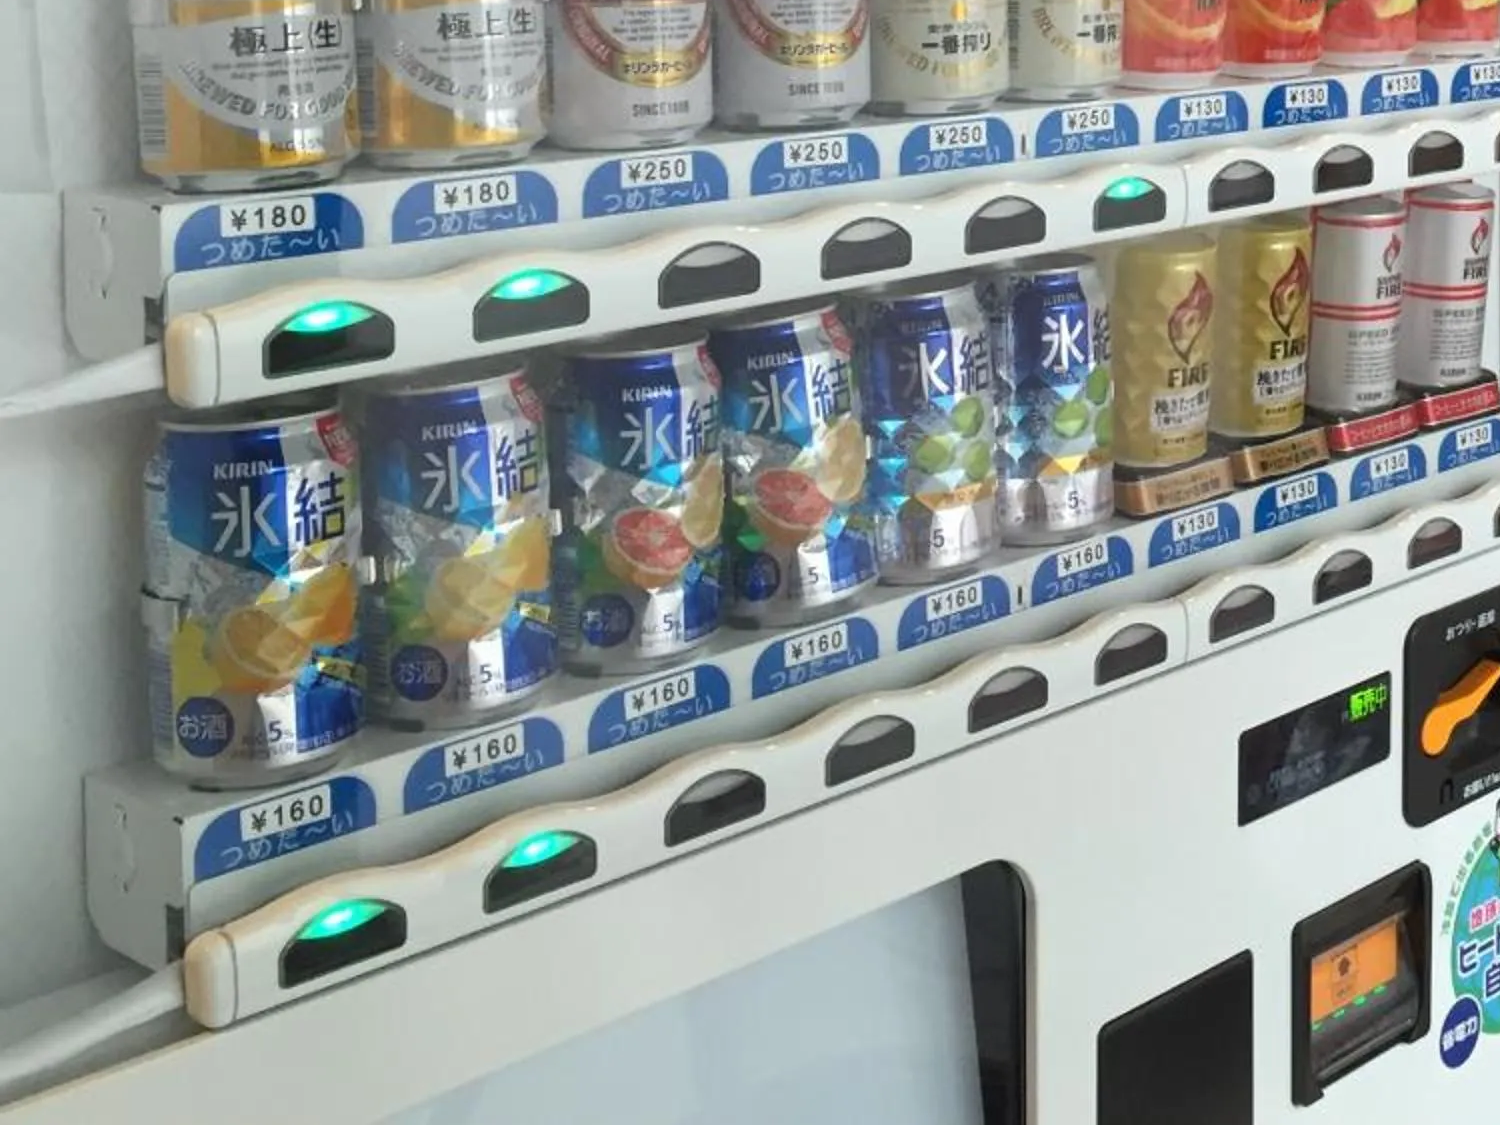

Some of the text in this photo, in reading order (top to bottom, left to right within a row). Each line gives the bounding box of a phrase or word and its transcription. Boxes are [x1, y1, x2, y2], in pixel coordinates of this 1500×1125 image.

[920, 30, 992, 56] 一番搾り
[1289, 86, 1327, 107] ¥130
[1383, 74, 1421, 95] ¥130
[1065, 108, 1112, 131] ¥250
[1182, 97, 1224, 119] ¥130
[933, 124, 984, 147] ¥250
[787, 140, 845, 163] ¥250
[626, 158, 689, 182] ¥250
[442, 180, 512, 210] ¥180
[229, 204, 308, 233] ¥180
[746, 350, 797, 371] KIRIN
[1167, 363, 1210, 389] FIRE
[621, 383, 674, 404] KIRIN
[748, 357, 850, 435] 氷結
[420, 422, 479, 443] KIRIN
[619, 393, 721, 472] 氷結
[1459, 425, 1490, 448] ¥130
[212, 459, 274, 482] KIRIN
[418, 427, 541, 514] 氷結
[1373, 453, 1409, 476] ¥130
[1280, 478, 1317, 505] ¥130
[210, 471, 346, 559] 氷結
[1176, 513, 1217, 537] ¥130
[1062, 542, 1105, 571] ¥160
[931, 587, 979, 616] ¥160
[785, 630, 843, 661] ¥160
[631, 677, 690, 711] ¥160
[177, 712, 229, 742] お酒
[451, 733, 518, 770] ¥160
[251, 794, 325, 834] ¥160
